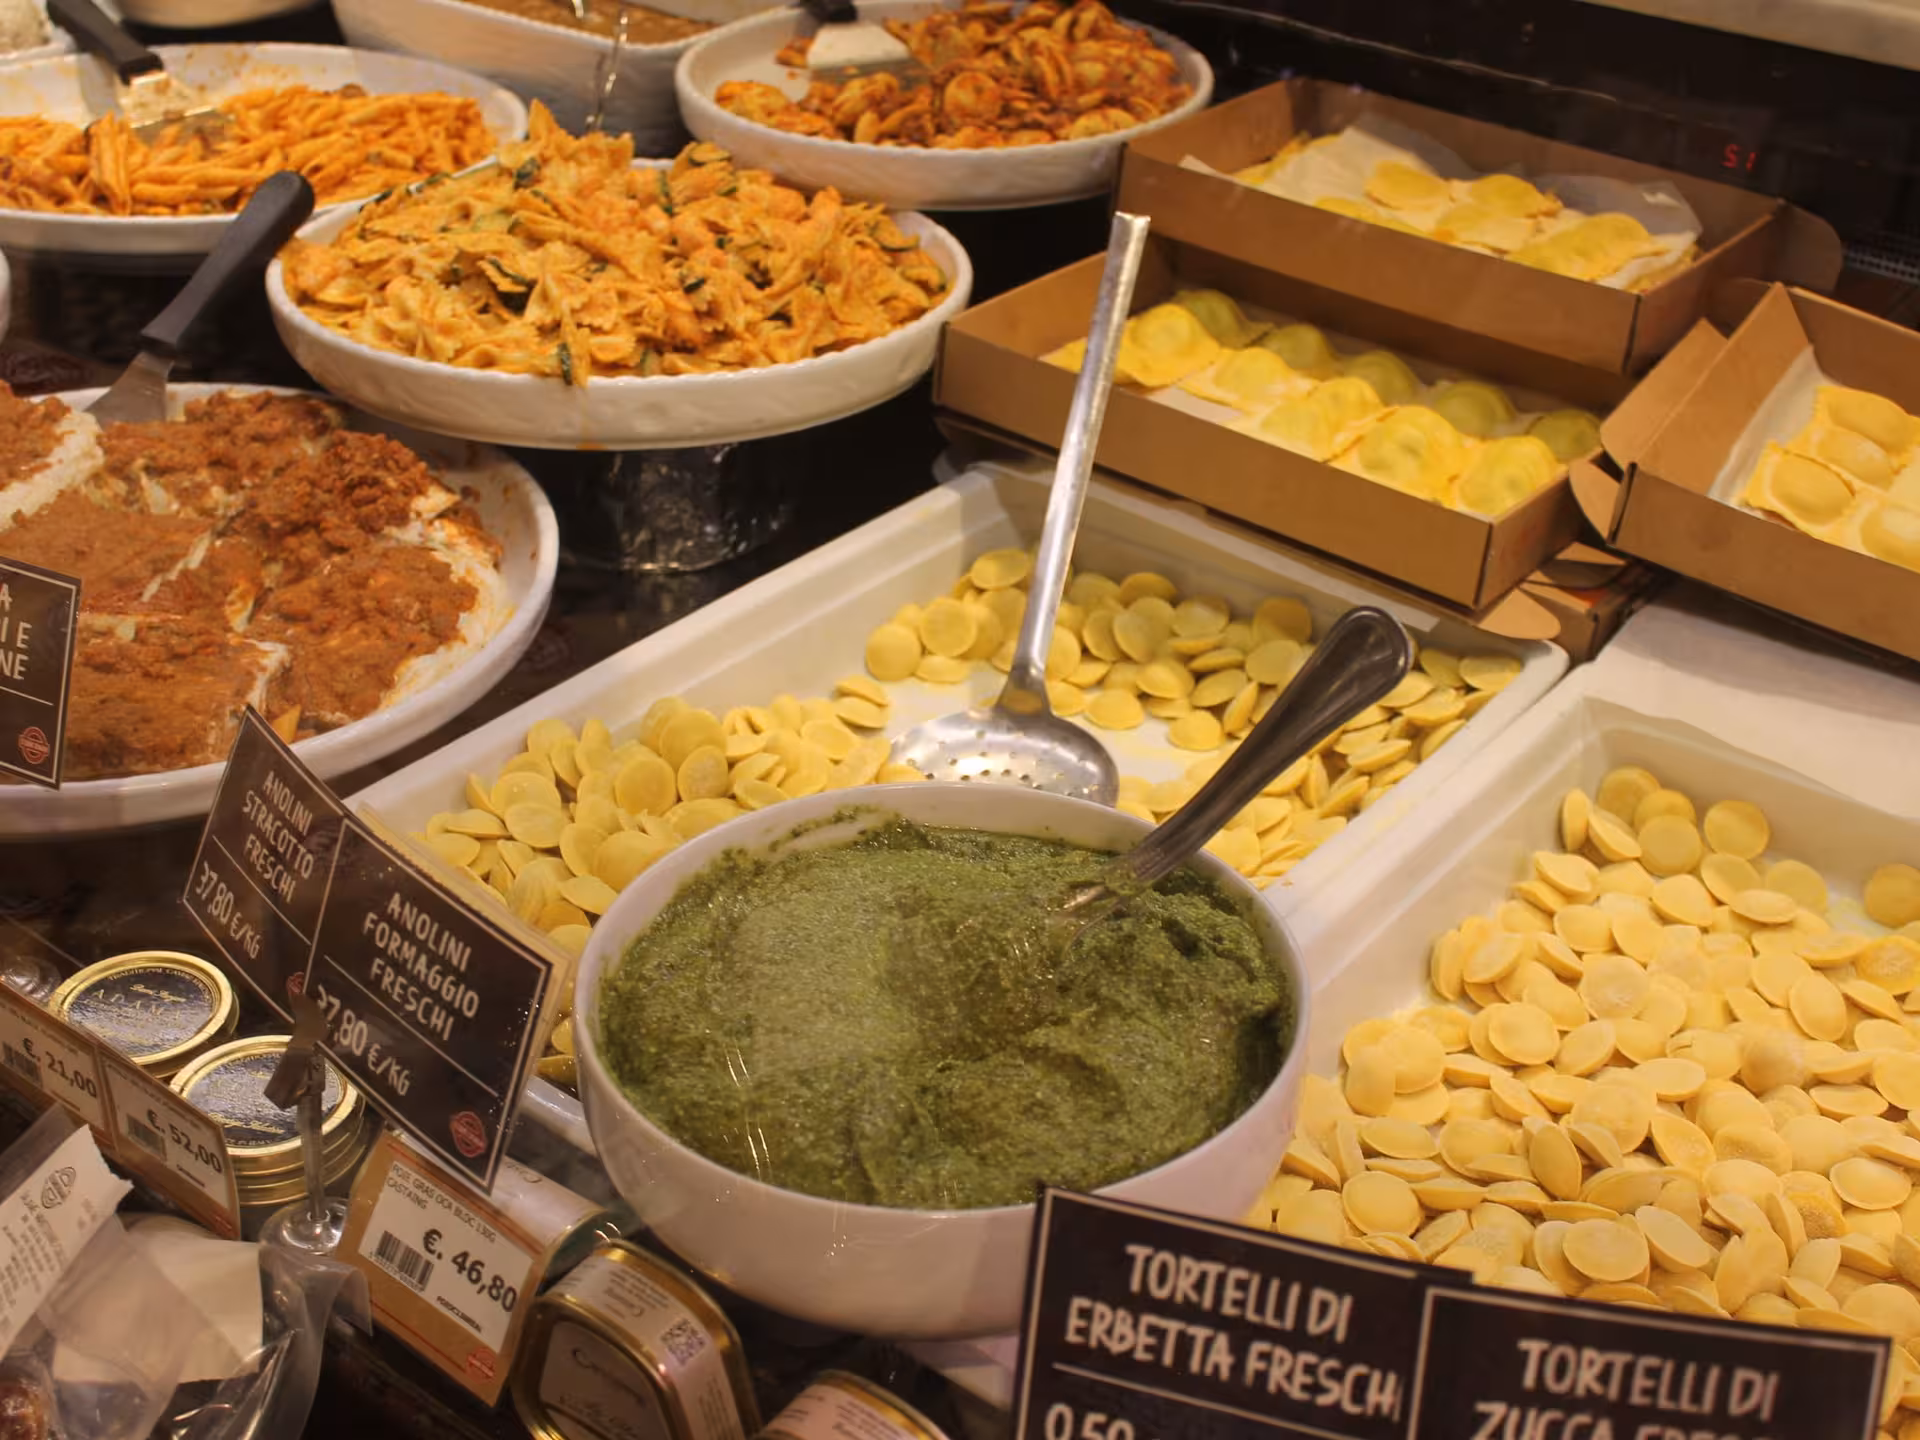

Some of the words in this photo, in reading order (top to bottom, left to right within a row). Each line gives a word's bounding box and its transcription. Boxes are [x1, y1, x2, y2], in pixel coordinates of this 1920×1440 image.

[242, 790, 314, 879] STRACOTTO
[263, 770, 312, 836] ANOLINI
[195, 861, 235, 925] 37,80
[243, 833, 296, 903] FRESCHI
[363, 912, 480, 1019] FORMAGGIO
[387, 892, 471, 972] ANOLINI
[370, 957, 454, 1041] FRESCHI
[47, 1053, 97, 1098] 21,00
[367, 1043, 410, 1096] €/KG
[170, 1124, 222, 1174] 52,00
[451, 1250, 519, 1313] 46,80
[1125, 1244, 1301, 1332] TORTELLI
[1305, 1286, 1354, 1343] DI
[1064, 1296, 1235, 1382] ERBETTA
[1517, 1338, 1721, 1415] TORTELLI
[1727, 1366, 1781, 1422] DI
